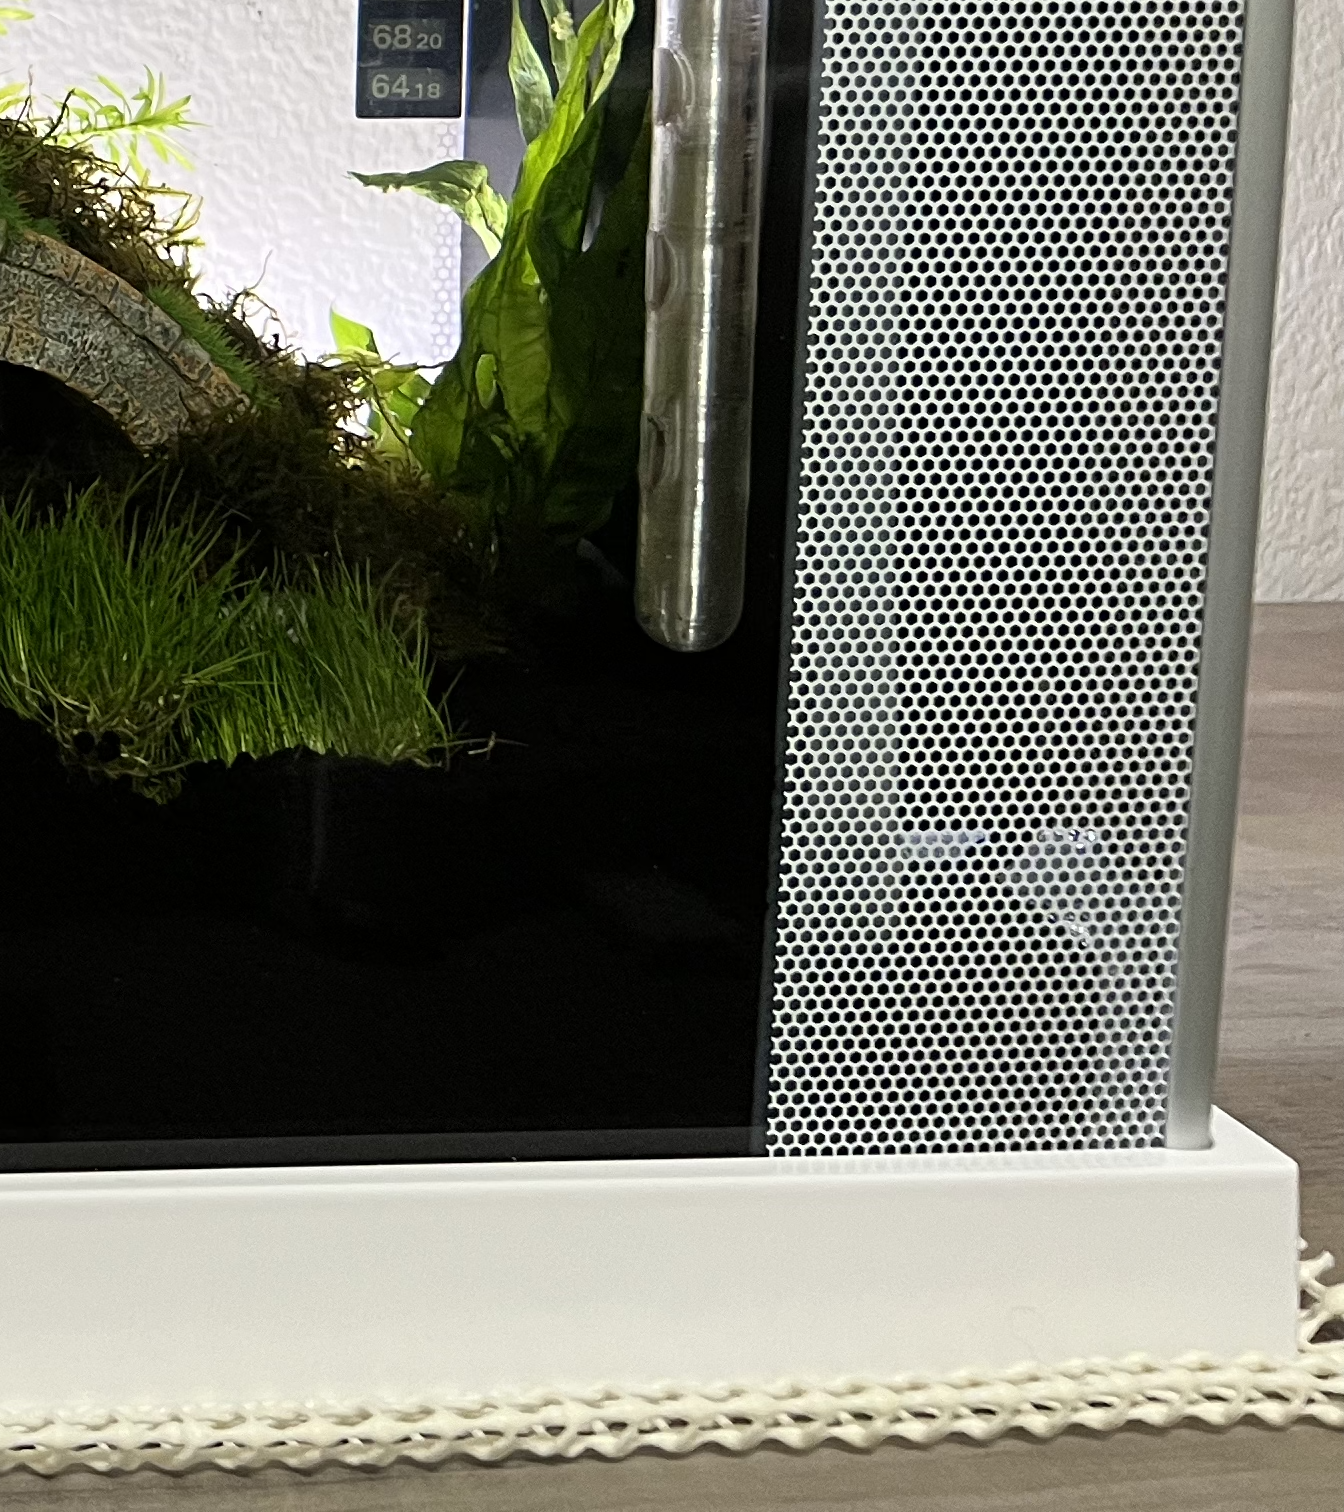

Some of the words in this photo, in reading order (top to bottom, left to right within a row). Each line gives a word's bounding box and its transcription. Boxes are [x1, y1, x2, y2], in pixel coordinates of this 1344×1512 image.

[372, 25, 412, 49] 68
[416, 35, 441, 49] 20
[372, 75, 410, 99] 64
[415, 84, 440, 98] 18
